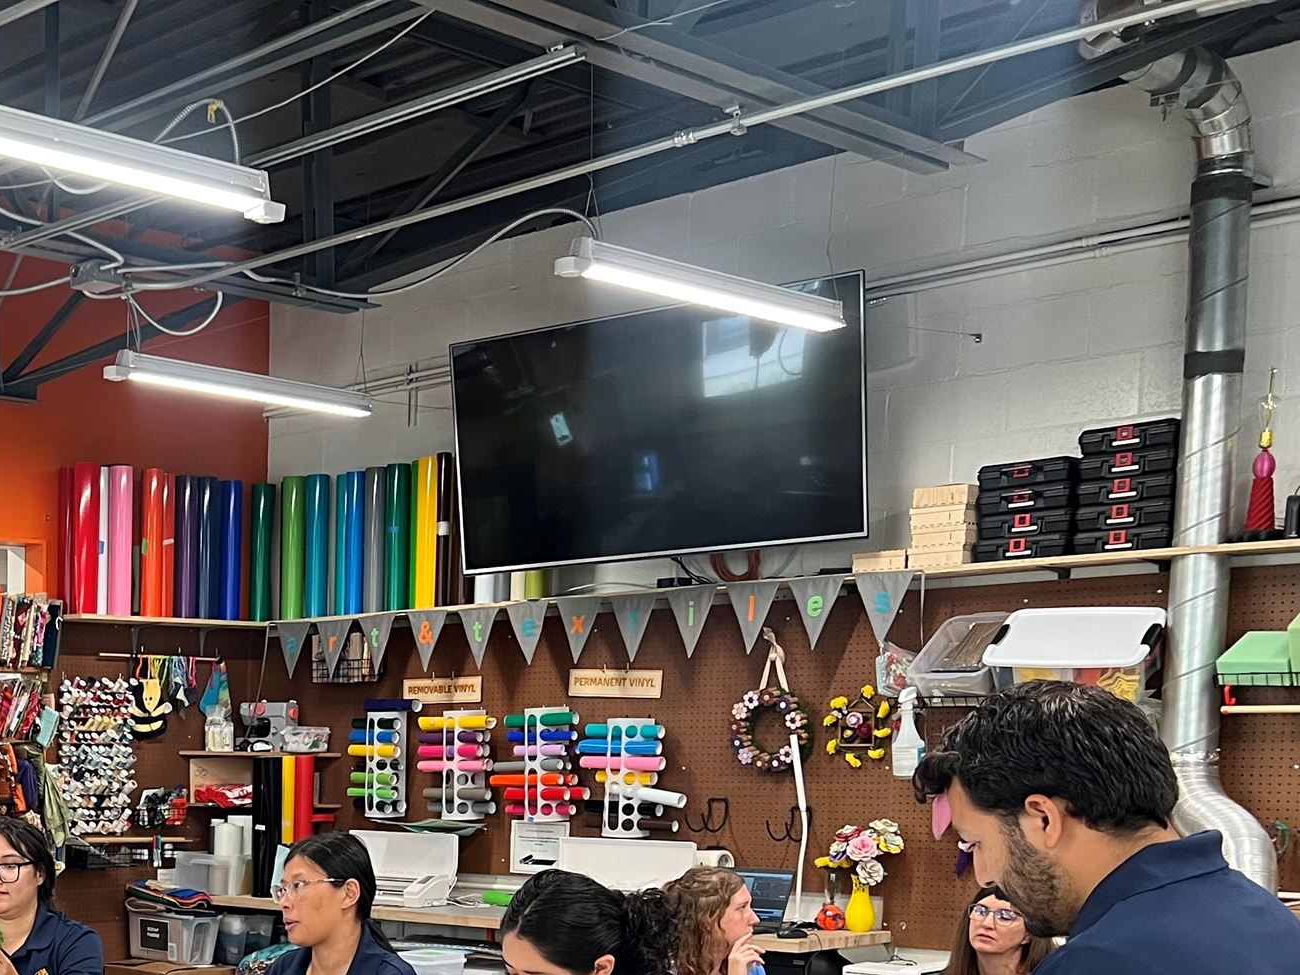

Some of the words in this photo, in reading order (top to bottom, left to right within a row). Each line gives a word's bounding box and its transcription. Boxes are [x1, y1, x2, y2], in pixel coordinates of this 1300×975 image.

[574, 677, 627, 688] PERMANENT
[629, 678, 656, 688] VINYL
[408, 685, 452, 695] REMOVABLE
[453, 684, 476, 693] VINYL
